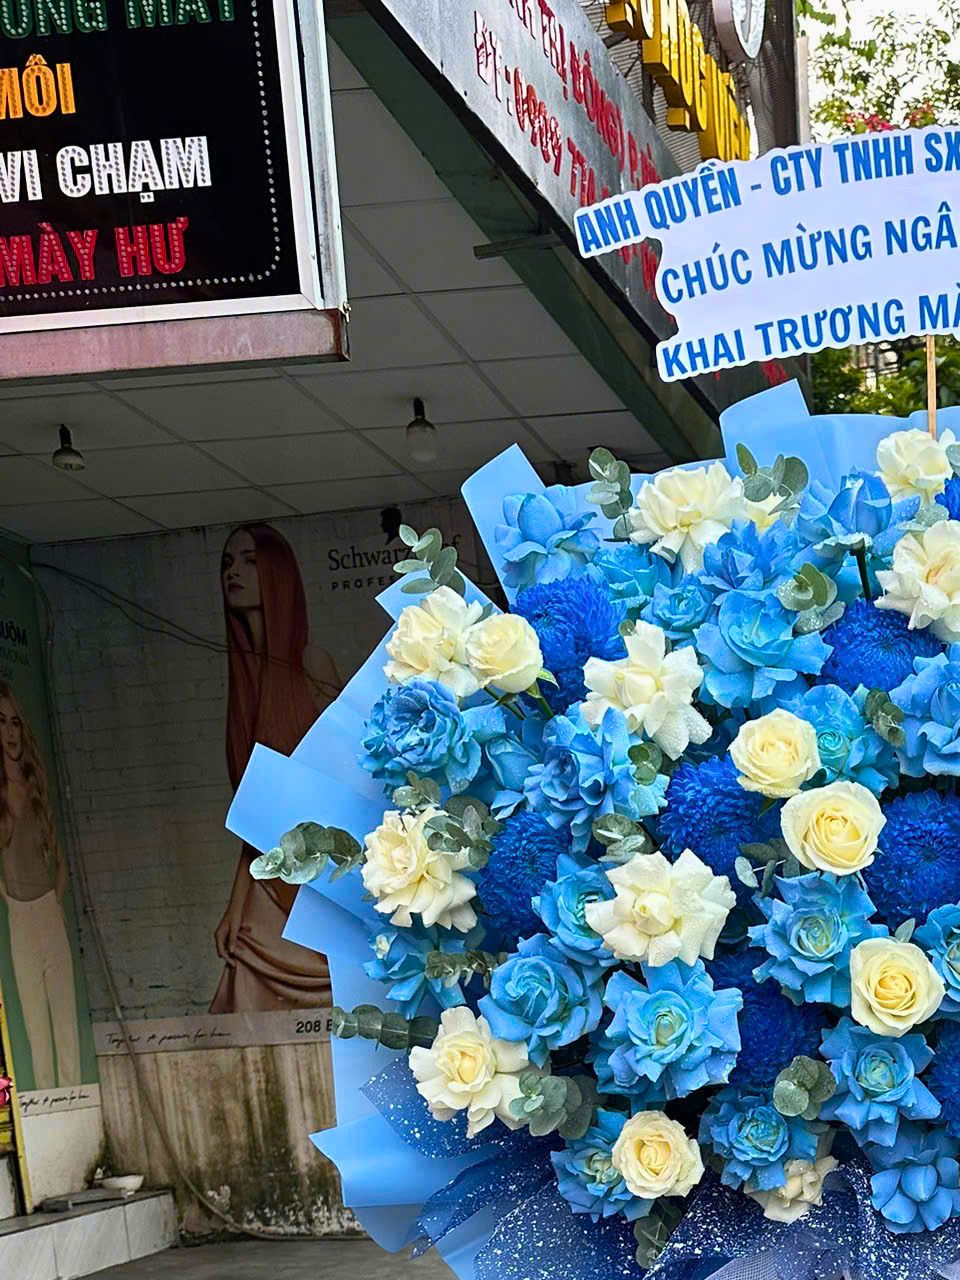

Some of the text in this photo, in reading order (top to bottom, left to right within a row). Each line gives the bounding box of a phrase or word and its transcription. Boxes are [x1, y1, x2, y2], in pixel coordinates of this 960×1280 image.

[56, 136, 212, 203] CHẠM
[576, 198, 641, 254] ANH
[644, 163, 742, 230] QUYỀN
[770, 147, 823, 196] CTY
[833, 134, 914, 184] TNHH
[0, 217, 189, 287] MÀY HƯ
[661, 243, 753, 304] CHÚC
[762, 223, 873, 278] MỪNG
[662, 328, 746, 378] KHAI
[754, 298, 906, 356] TRƯƠNG
[295, 1019, 322, 1035] 208
